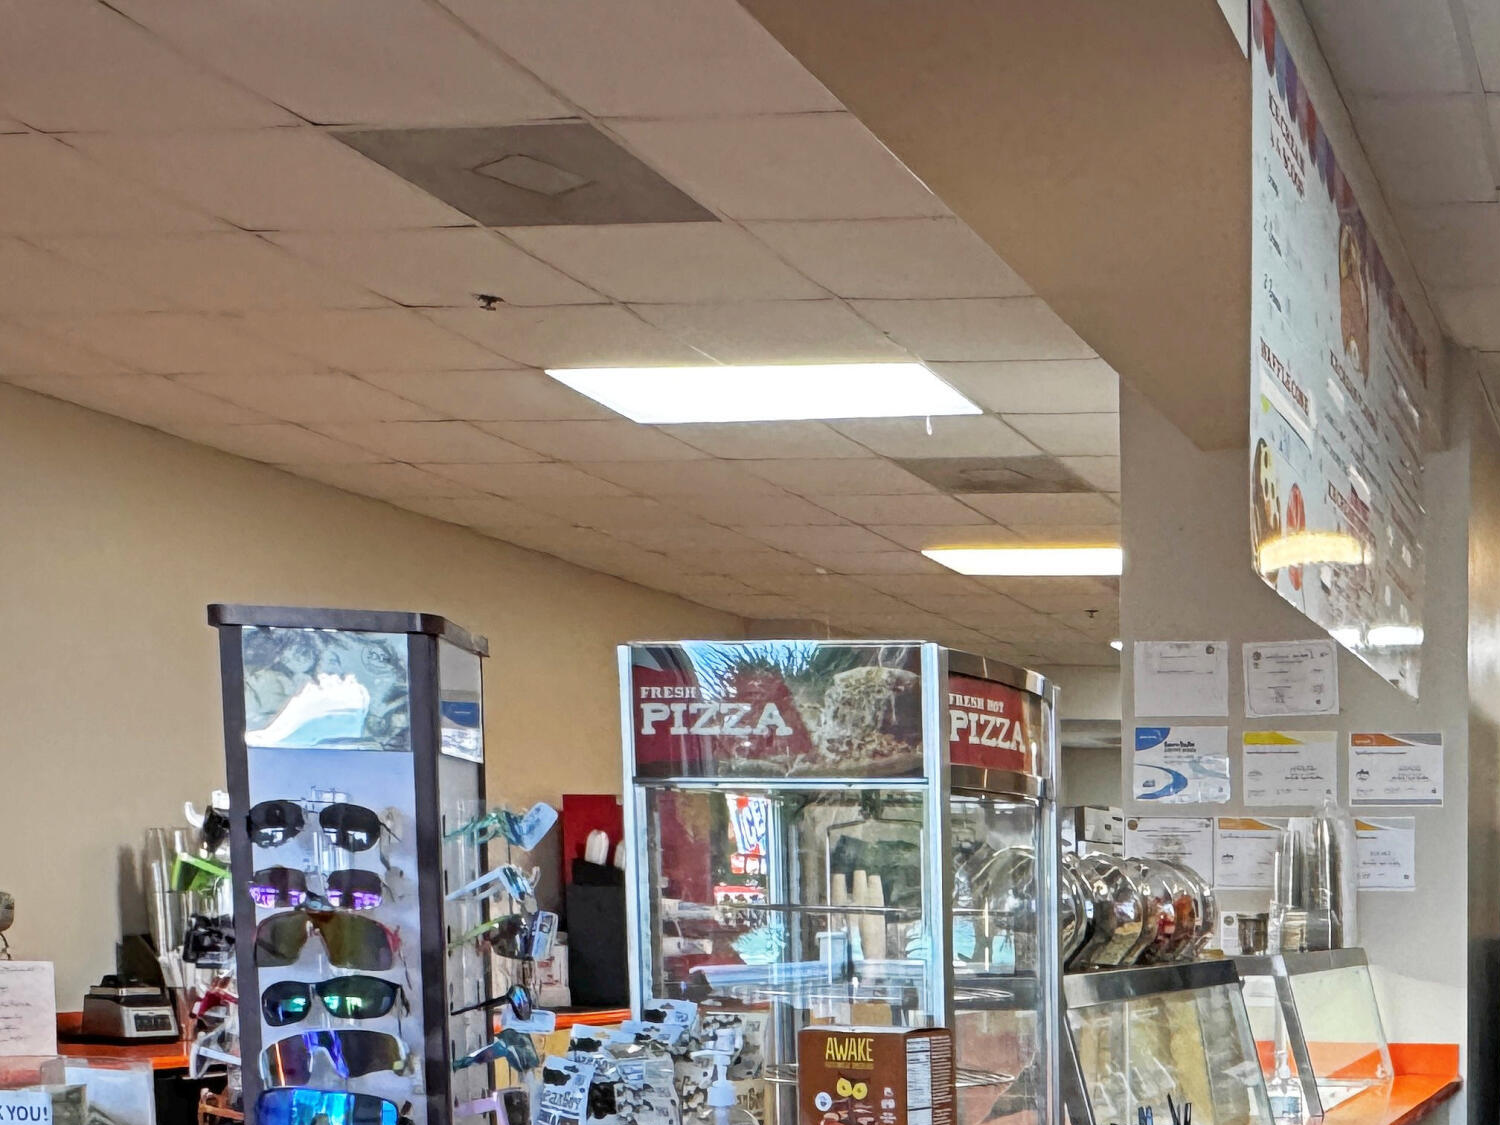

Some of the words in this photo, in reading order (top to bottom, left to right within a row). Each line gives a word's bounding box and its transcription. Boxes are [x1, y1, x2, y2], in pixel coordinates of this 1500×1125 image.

[639, 686, 698, 699] FRESH
[948, 693, 985, 710] FRESH
[639, 702, 793, 736] PIZZA
[949, 709, 1026, 753] PIZZA
[825, 1036, 875, 1063] AWAKE
[6, 1105, 49, 1122] YOU!
